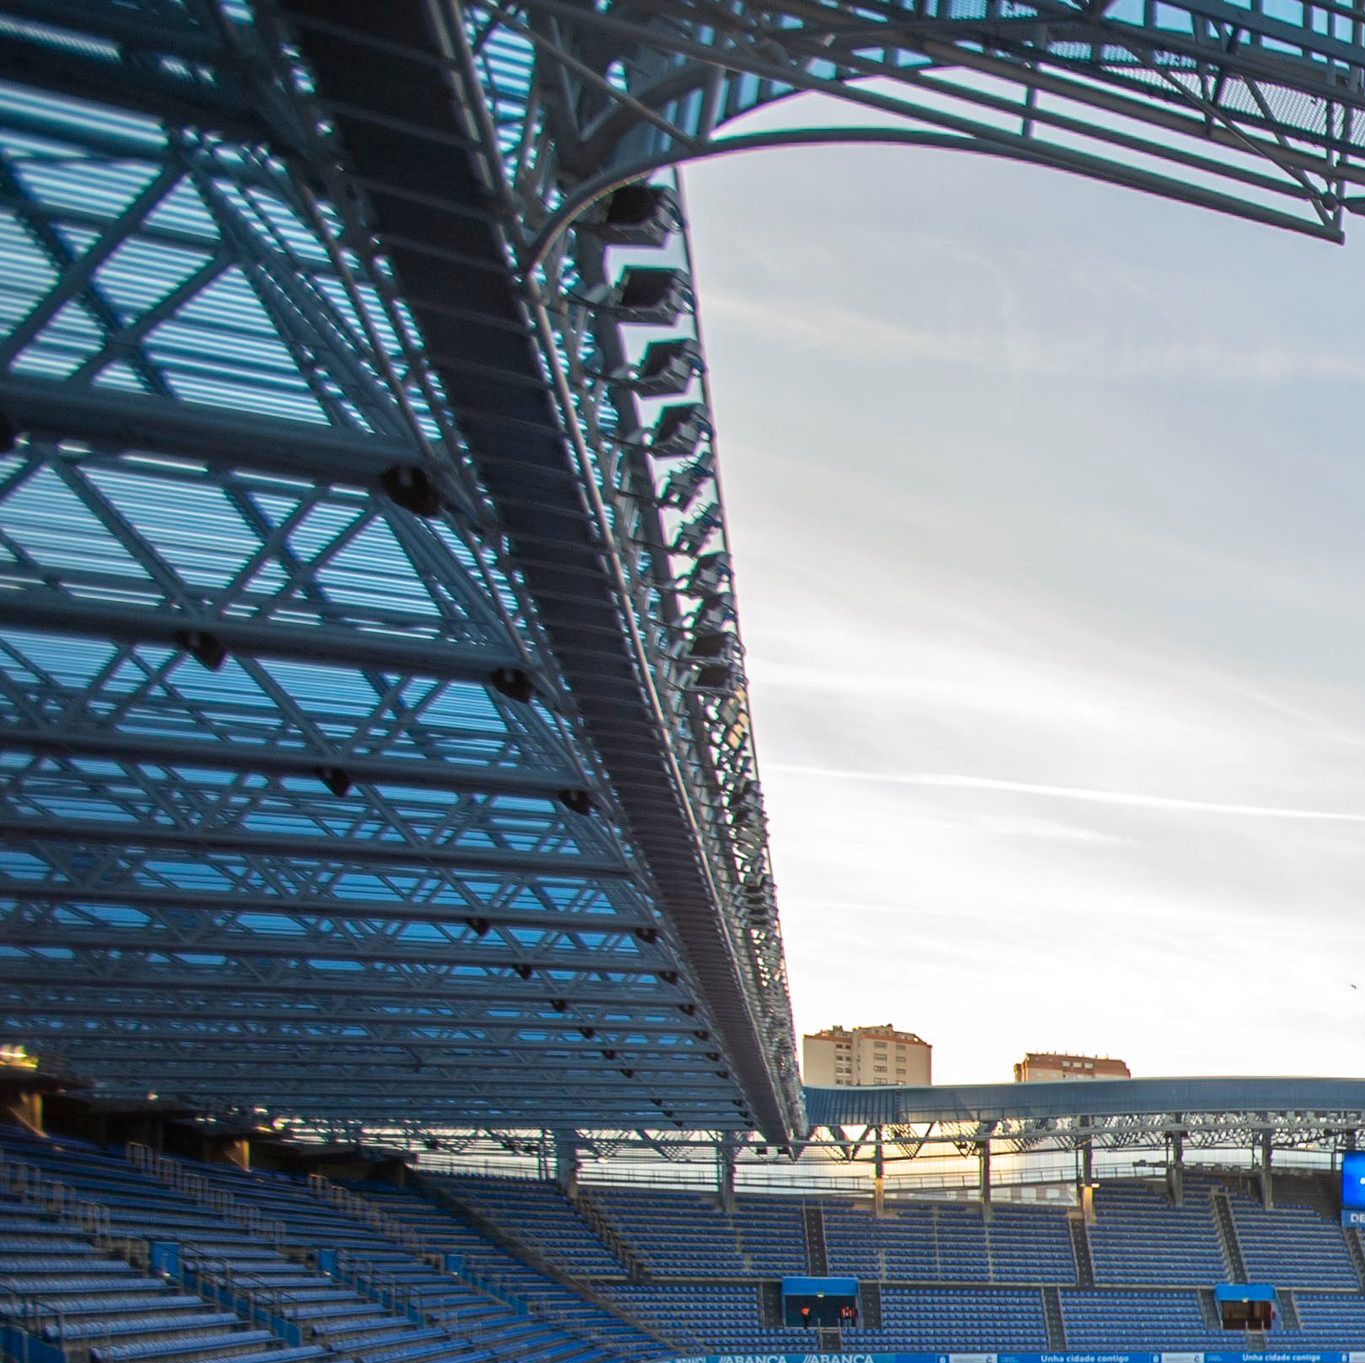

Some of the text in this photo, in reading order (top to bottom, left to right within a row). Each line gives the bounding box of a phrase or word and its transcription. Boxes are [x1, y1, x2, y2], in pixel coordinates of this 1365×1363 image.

[1041, 1354, 1129, 1363] Unha cidade contigo
